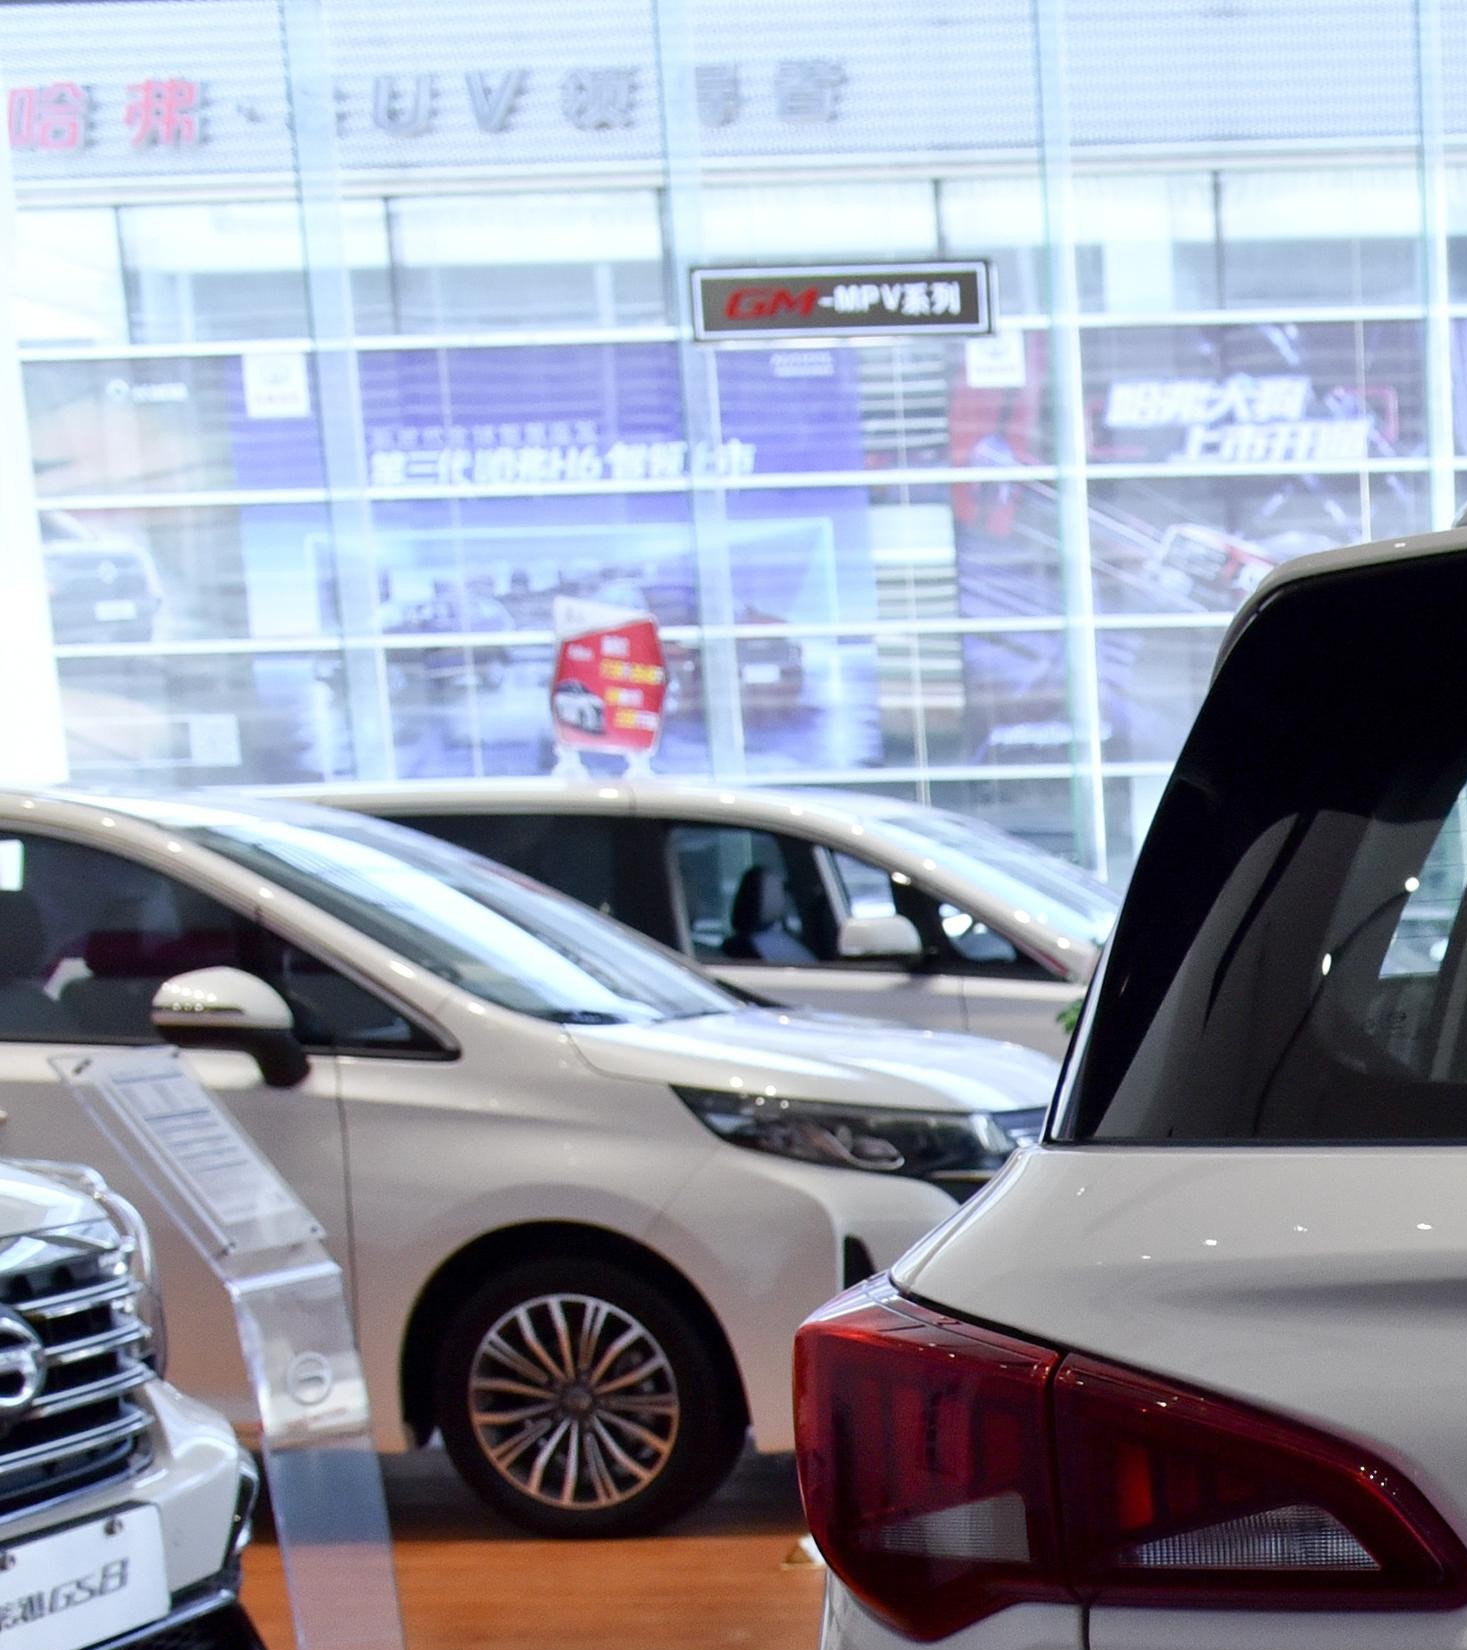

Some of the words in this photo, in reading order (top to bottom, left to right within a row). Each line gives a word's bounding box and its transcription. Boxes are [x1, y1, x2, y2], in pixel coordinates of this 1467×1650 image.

[7, 58, 849, 152] 哈弗·UV领导者
[725, 279, 961, 321] GM-MPV系列
